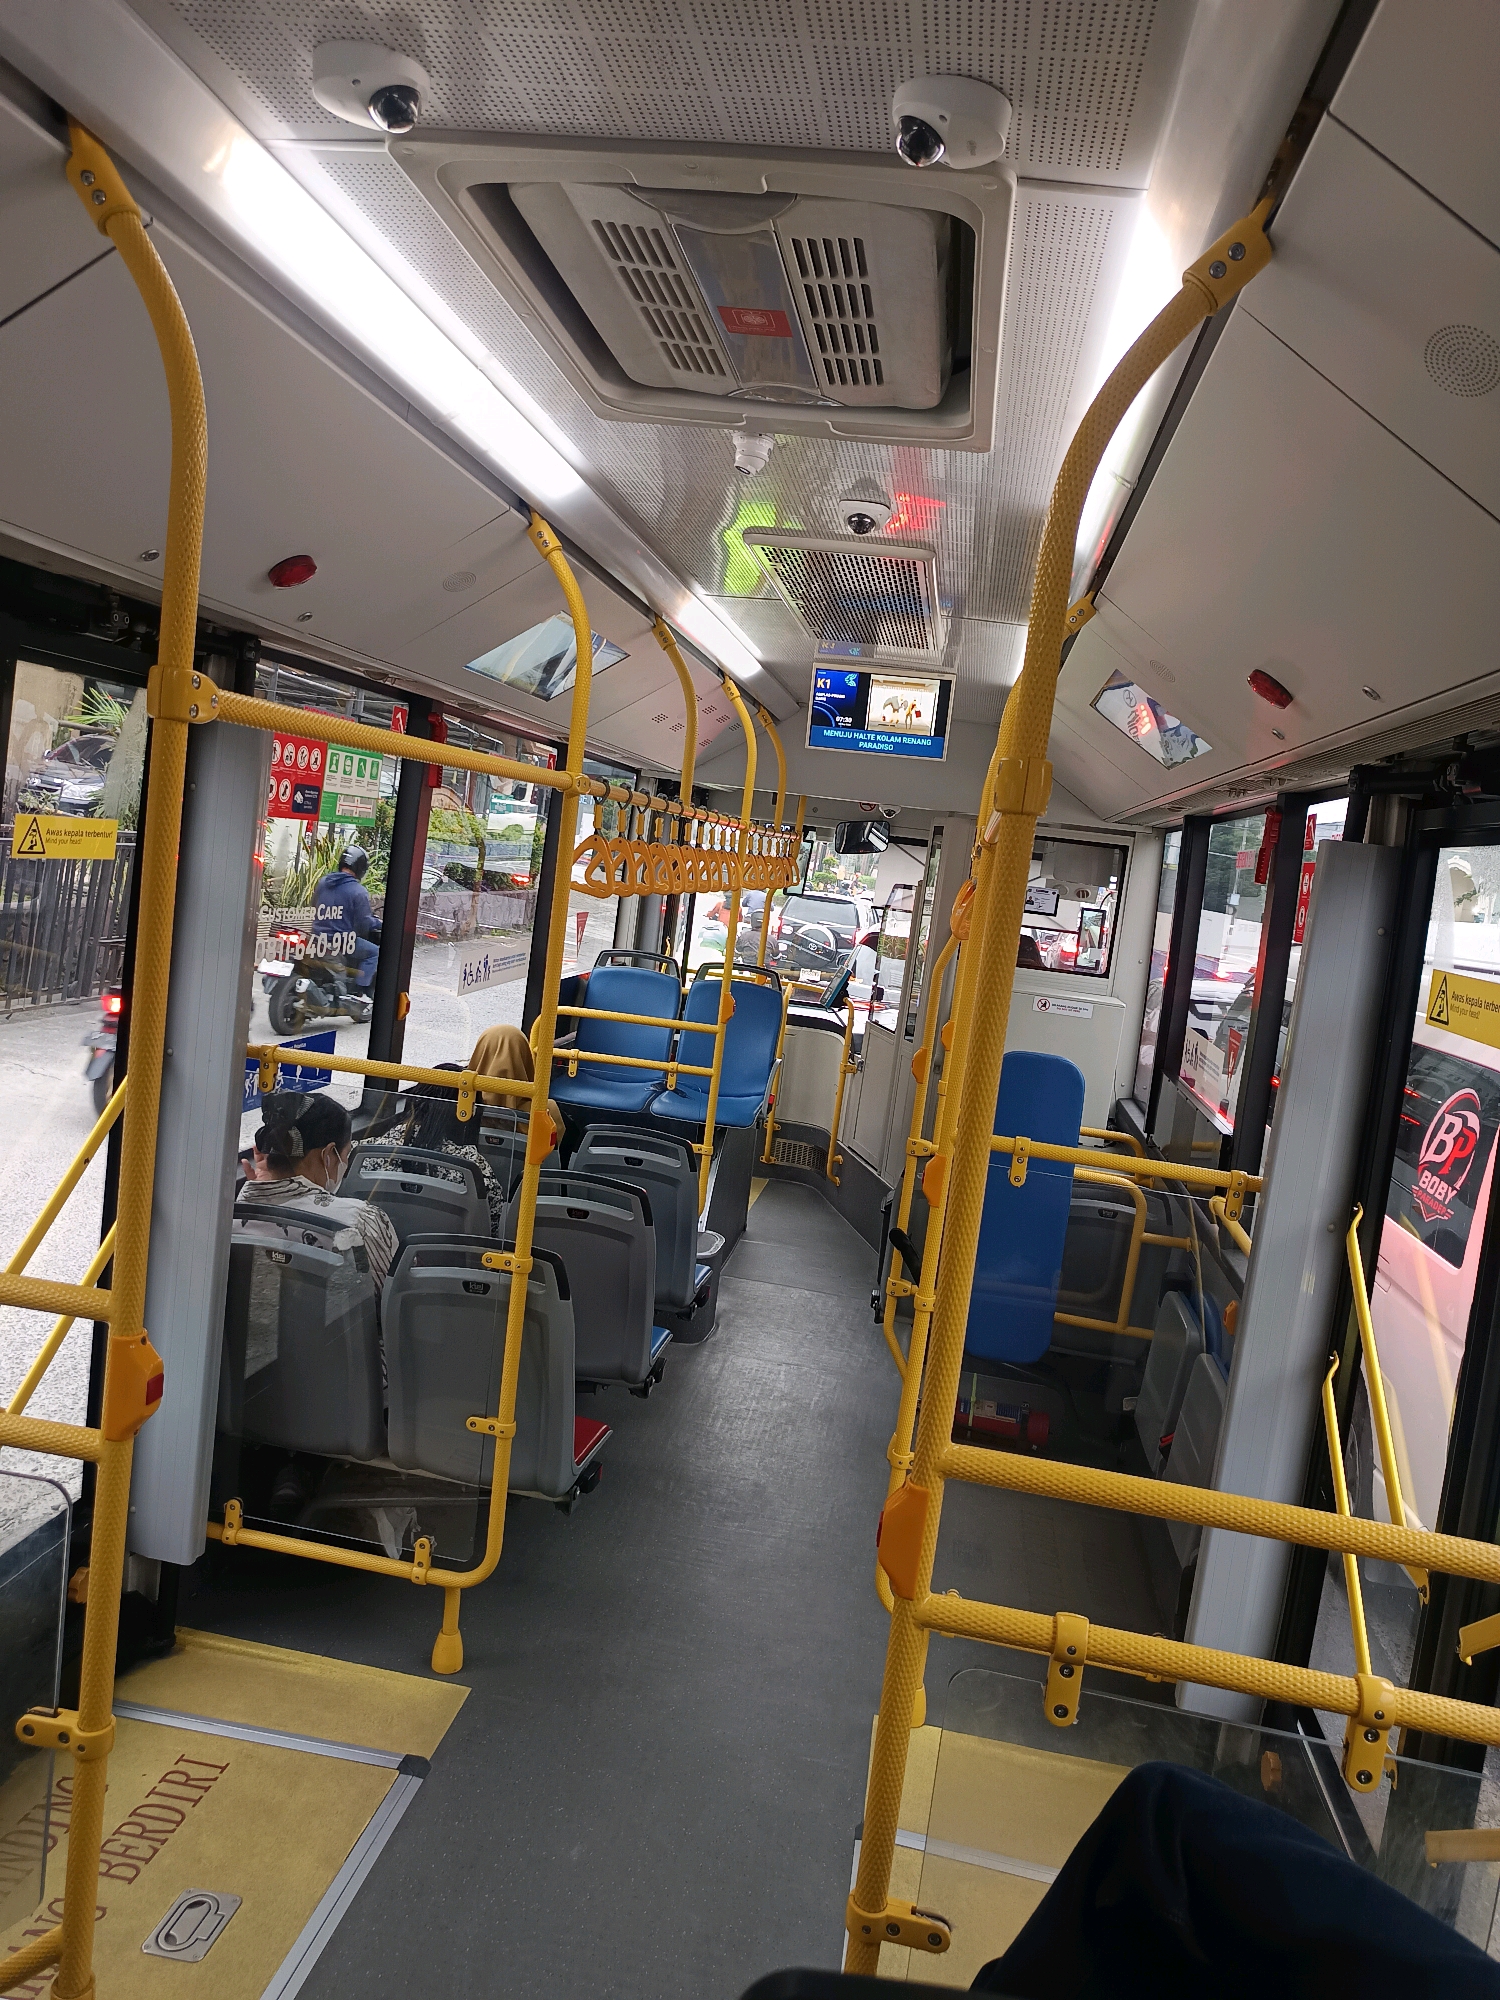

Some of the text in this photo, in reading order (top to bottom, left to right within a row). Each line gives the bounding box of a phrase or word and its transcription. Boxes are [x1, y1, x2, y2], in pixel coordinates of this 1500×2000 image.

[817, 678, 831, 689] K1
[823, 729, 932, 746] MENUJU HALTE KOLAM RENANG
[858, 741, 894, 751] PARADISO
[46, 828, 113, 839] Awas kepala terbentur!
[58, 838, 69, 846] your
[259, 903, 344, 921] CUSTOMER CARE
[255, 930, 357, 963] 0811-640-918
[1451, 991, 1465, 1004] Awas
[1465, 993, 1483, 1008] kepala
[1450, 1003, 1460, 1013] Mind
[1460, 1007, 1468, 1016] your
[1418, 1169, 1458, 1205] BOBY
[469, 1281, 484, 1291] kiel
[98, 1753, 231, 1885] BERDIRI
